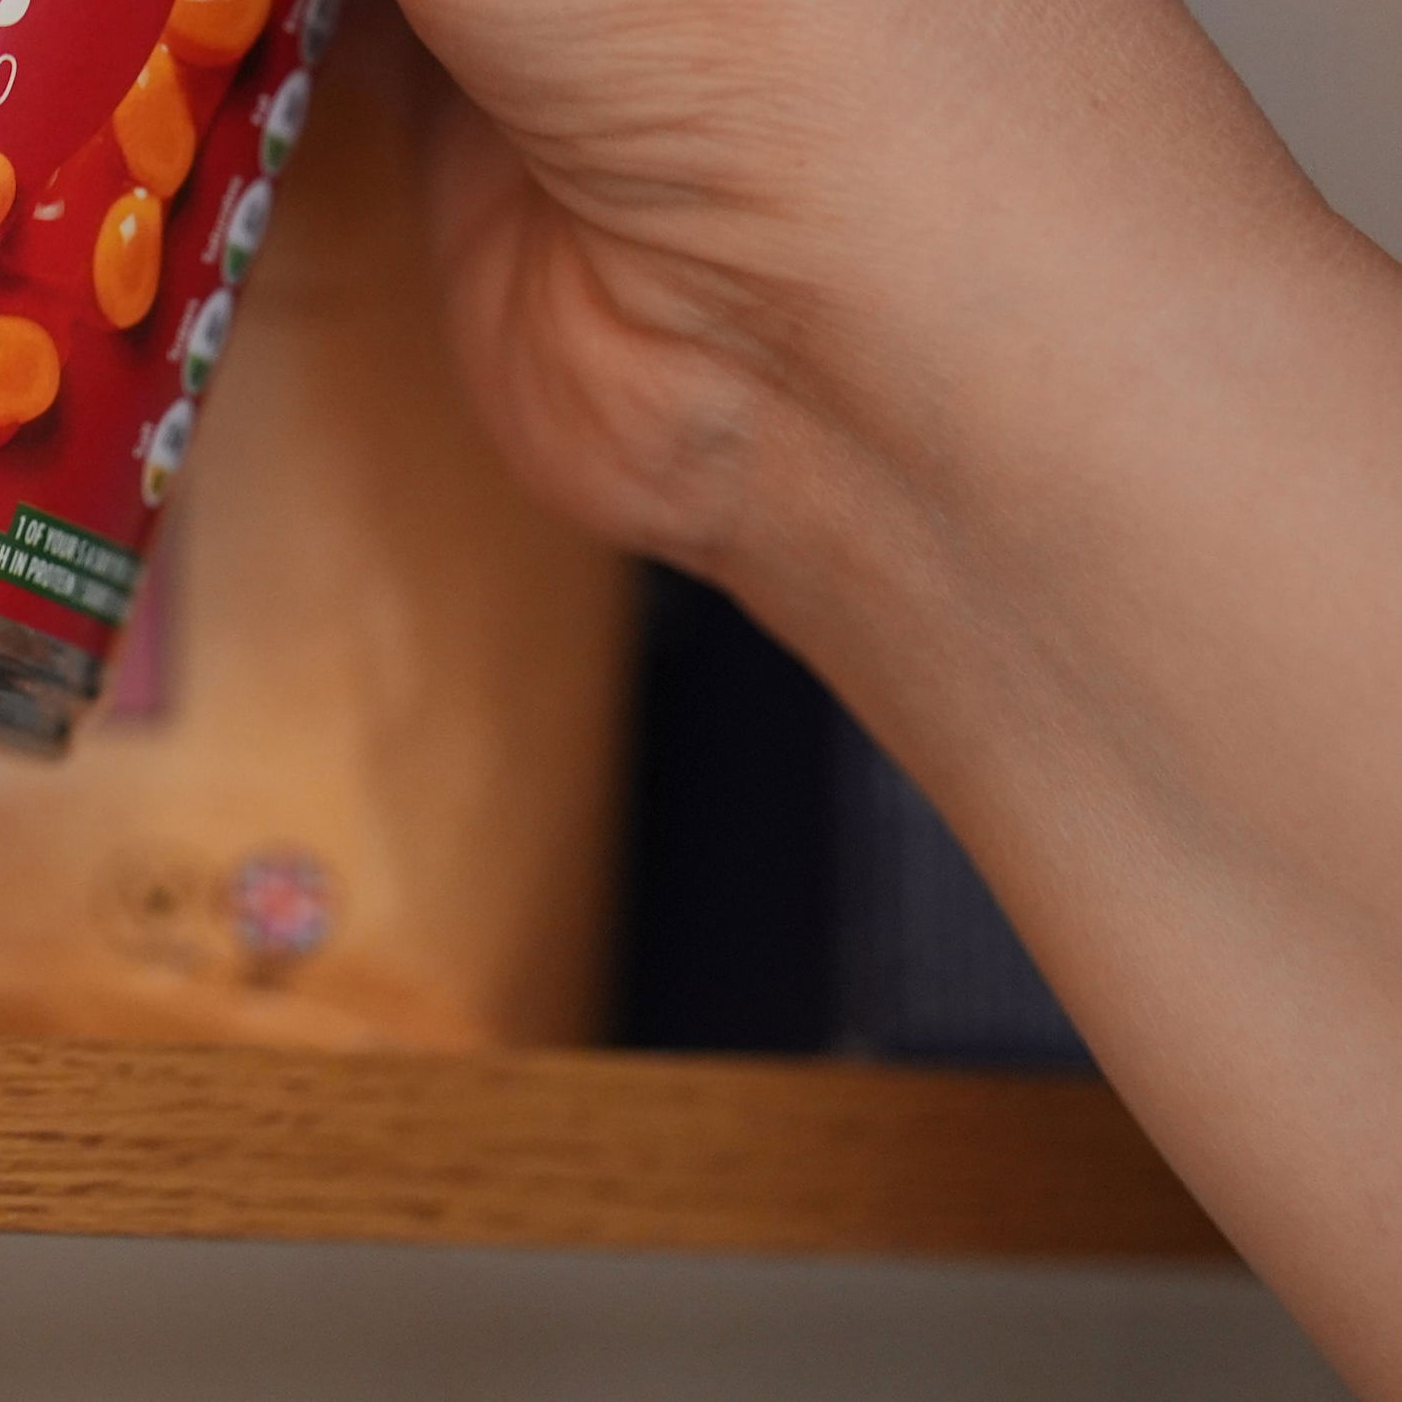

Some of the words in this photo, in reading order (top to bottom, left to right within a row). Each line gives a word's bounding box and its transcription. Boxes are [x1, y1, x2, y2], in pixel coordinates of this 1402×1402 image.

[15, 515, 27, 540] 1
[25, 519, 46, 546] OF
[9, 551, 28, 576] IN
